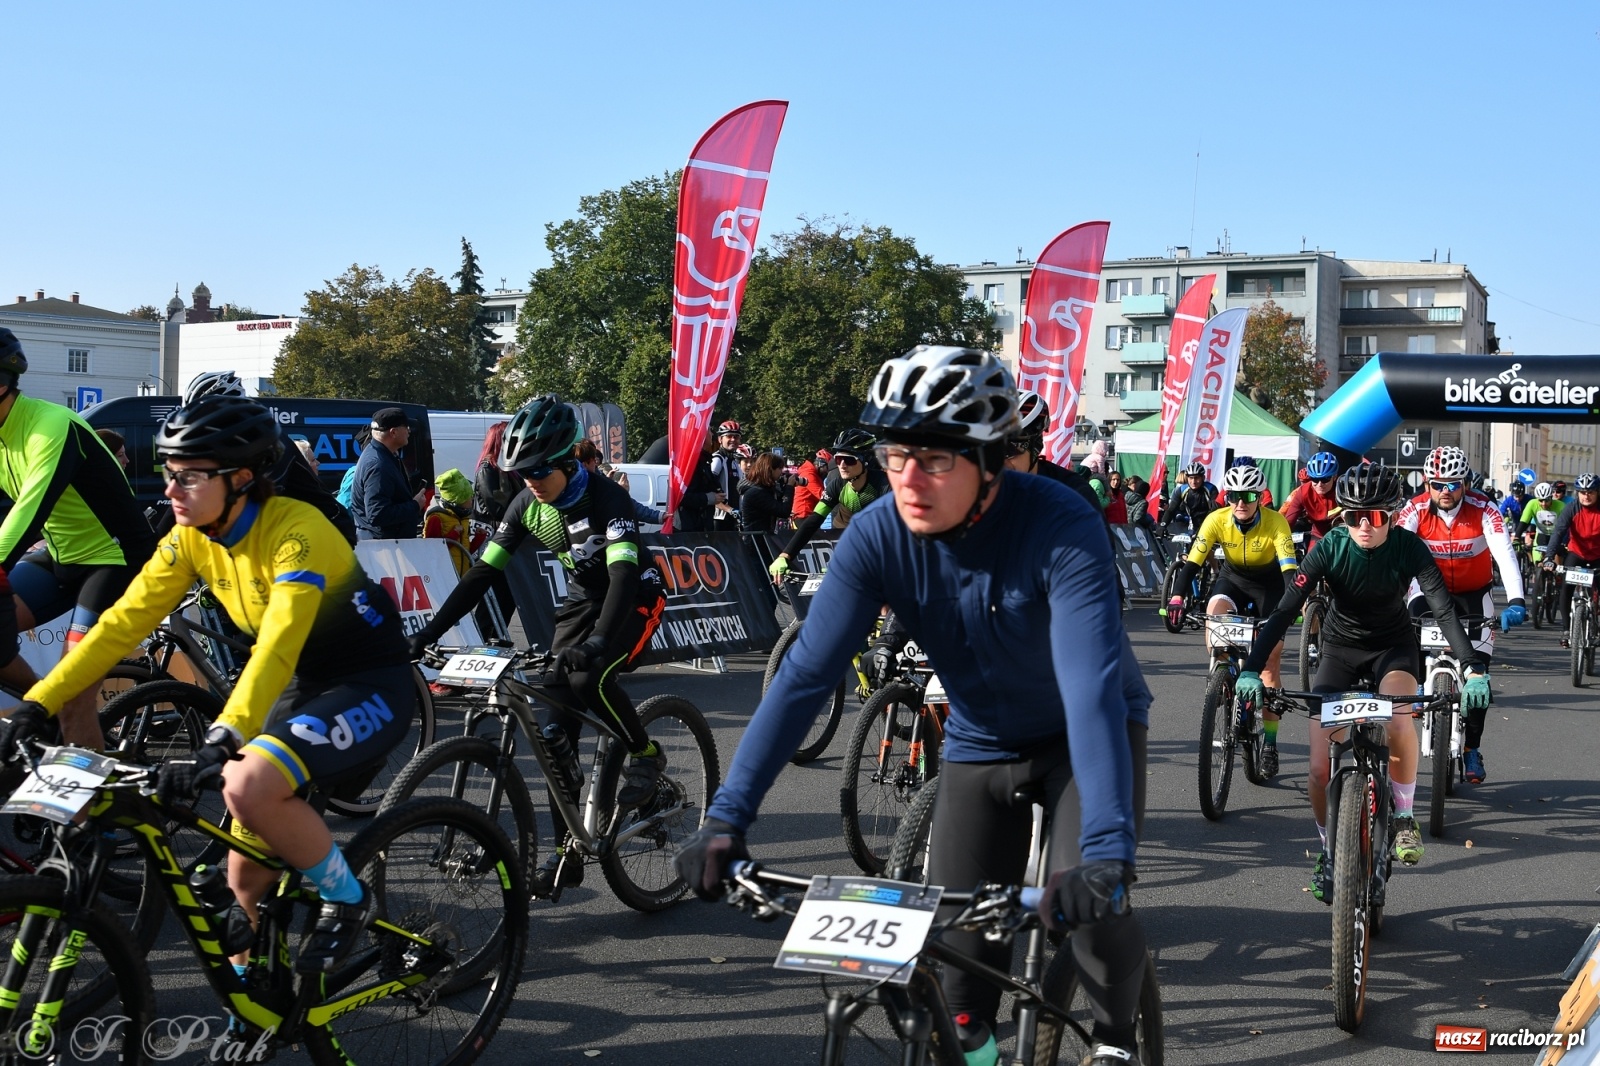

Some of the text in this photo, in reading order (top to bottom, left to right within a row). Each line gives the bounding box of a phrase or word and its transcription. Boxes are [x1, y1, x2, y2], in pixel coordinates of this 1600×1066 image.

[1444, 377, 1600, 405] bike atelier
[1428, 542, 1474, 553] RAFAKO
[1571, 573, 1589, 582] 3160
[1431, 631, 1446, 642] 31
[455, 659, 497, 673] 1504
[1332, 702, 1379, 716] 3078
[809, 914, 902, 948] 2245
